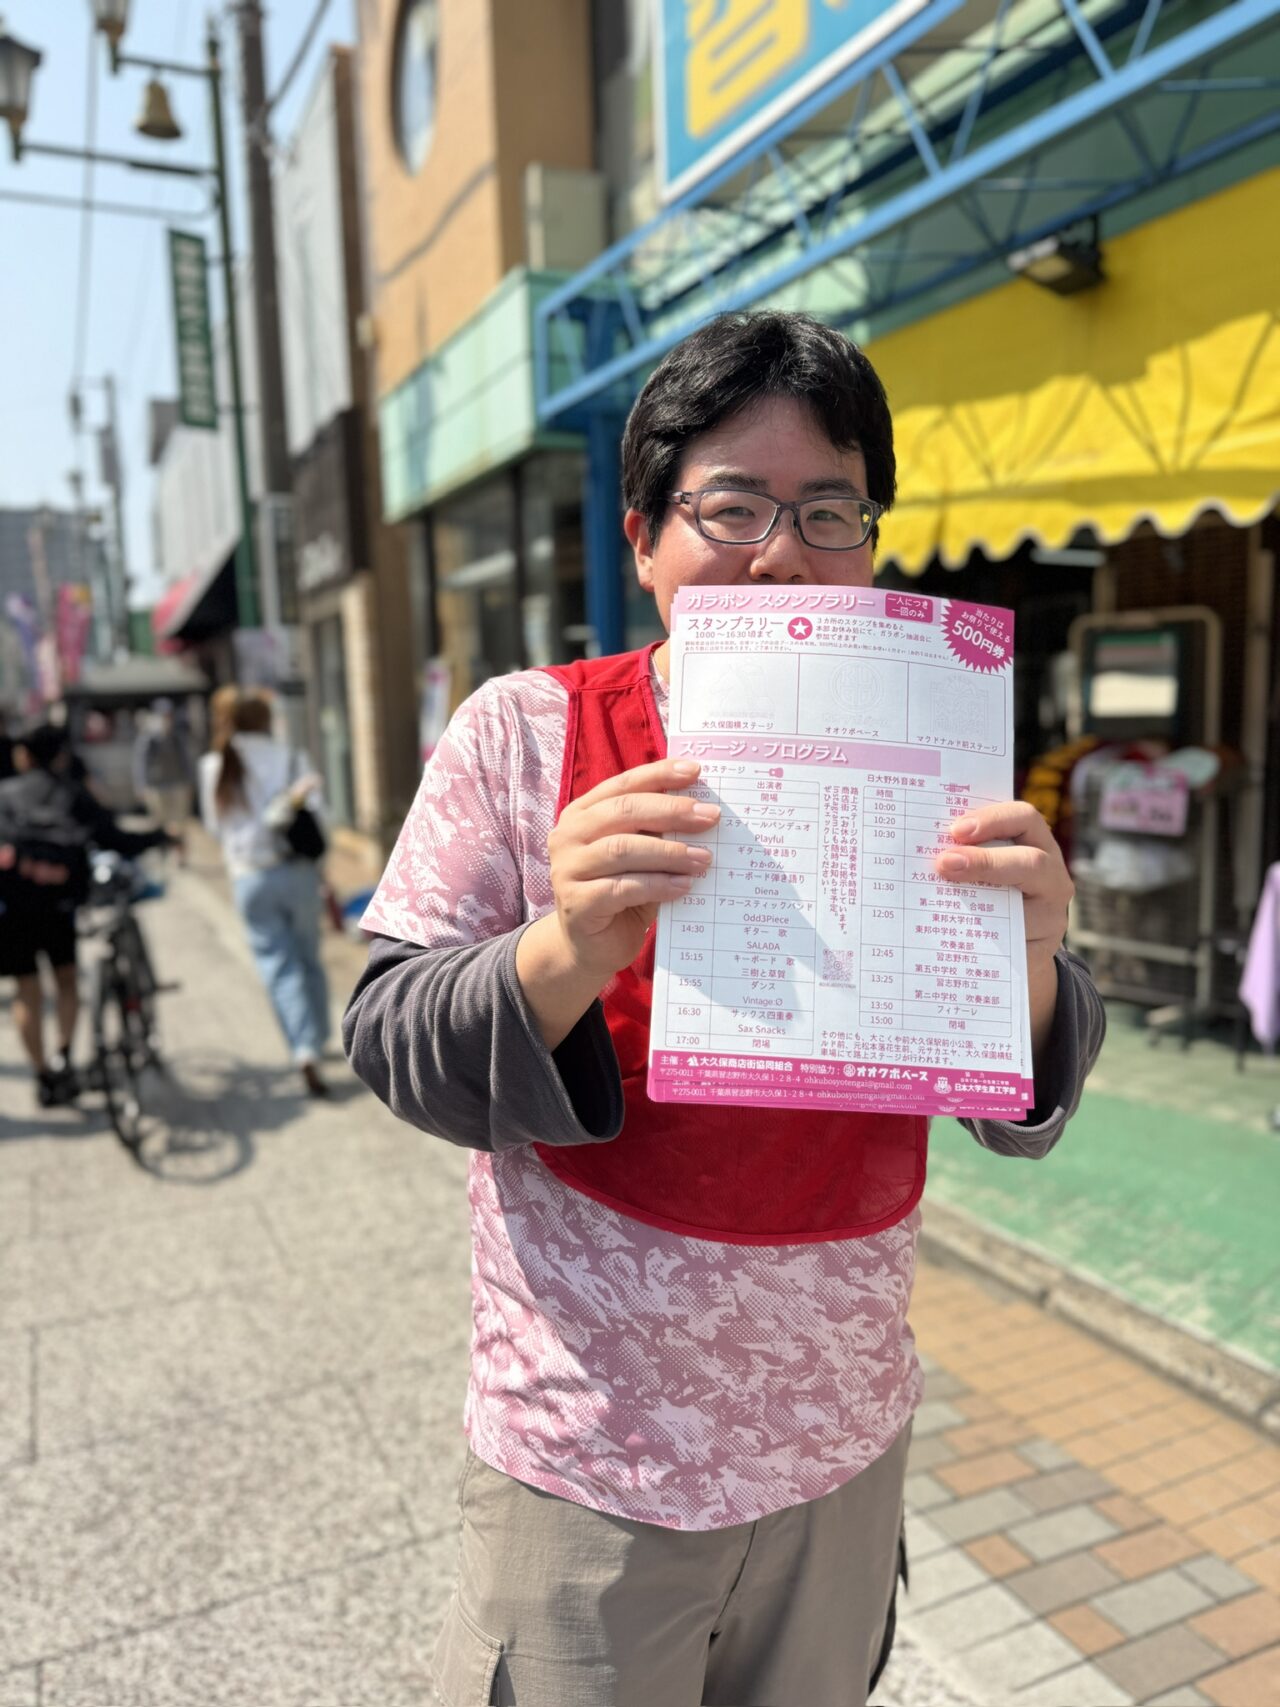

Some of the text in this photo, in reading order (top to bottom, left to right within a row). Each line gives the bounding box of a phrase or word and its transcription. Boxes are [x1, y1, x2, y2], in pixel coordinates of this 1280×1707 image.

[759, 593, 875, 610] スタンプラリー
[887, 596, 929, 610] 一人につき
[891, 607, 926, 619] 一回のみ
[976, 608, 1005, 629] 当たりは
[688, 617, 784, 631] スタンプラリー
[961, 611, 1011, 644] お祭りで使える
[952, 620, 1006, 659] 500円券
[679, 741, 849, 763] ステージ・プログラム
[757, 781, 783, 791] 出演者
[867, 775, 926, 788] 日大野外音楽堂
[688, 790, 711, 799] 10:00
[876, 789, 894, 799] 時間
[945, 796, 969, 807] 出演者
[874, 802, 896, 812] 10:00
[874, 816, 896, 825] 10:20
[754, 834, 785, 844] Playful
[873, 829, 896, 839] 10:30
[750, 861, 784, 870] わかのん
[873, 856, 895, 866] 11:00
[754, 887, 780, 896] Diena
[872, 882, 895, 891] 11:30
[936, 886, 978, 898] 習志野市立
[682, 897, 706, 906] 13:30
[743, 914, 790, 924] Odd3Piece
[872, 909, 895, 919] 12:05
[681, 924, 705, 934] 14:30
[747, 941, 780, 951] SALADA
[680, 951, 704, 961] 15:15
[871, 948, 894, 958] 12:45
[936, 952, 979, 964] 習志野市立
[679, 978, 703, 988] 15:55
[871, 974, 894, 984] 13:25
[936, 977, 979, 990] 習志野市立
[751, 981, 776, 990] ダンス
[871, 1001, 893, 1011] 13:50
[937, 1005, 978, 1016] フィナーレ
[677, 1007, 701, 1016] 16:30
[870, 1015, 893, 1025] 15:00
[738, 1024, 787, 1036] Sax Snacks
[676, 1035, 700, 1045] 17:00
